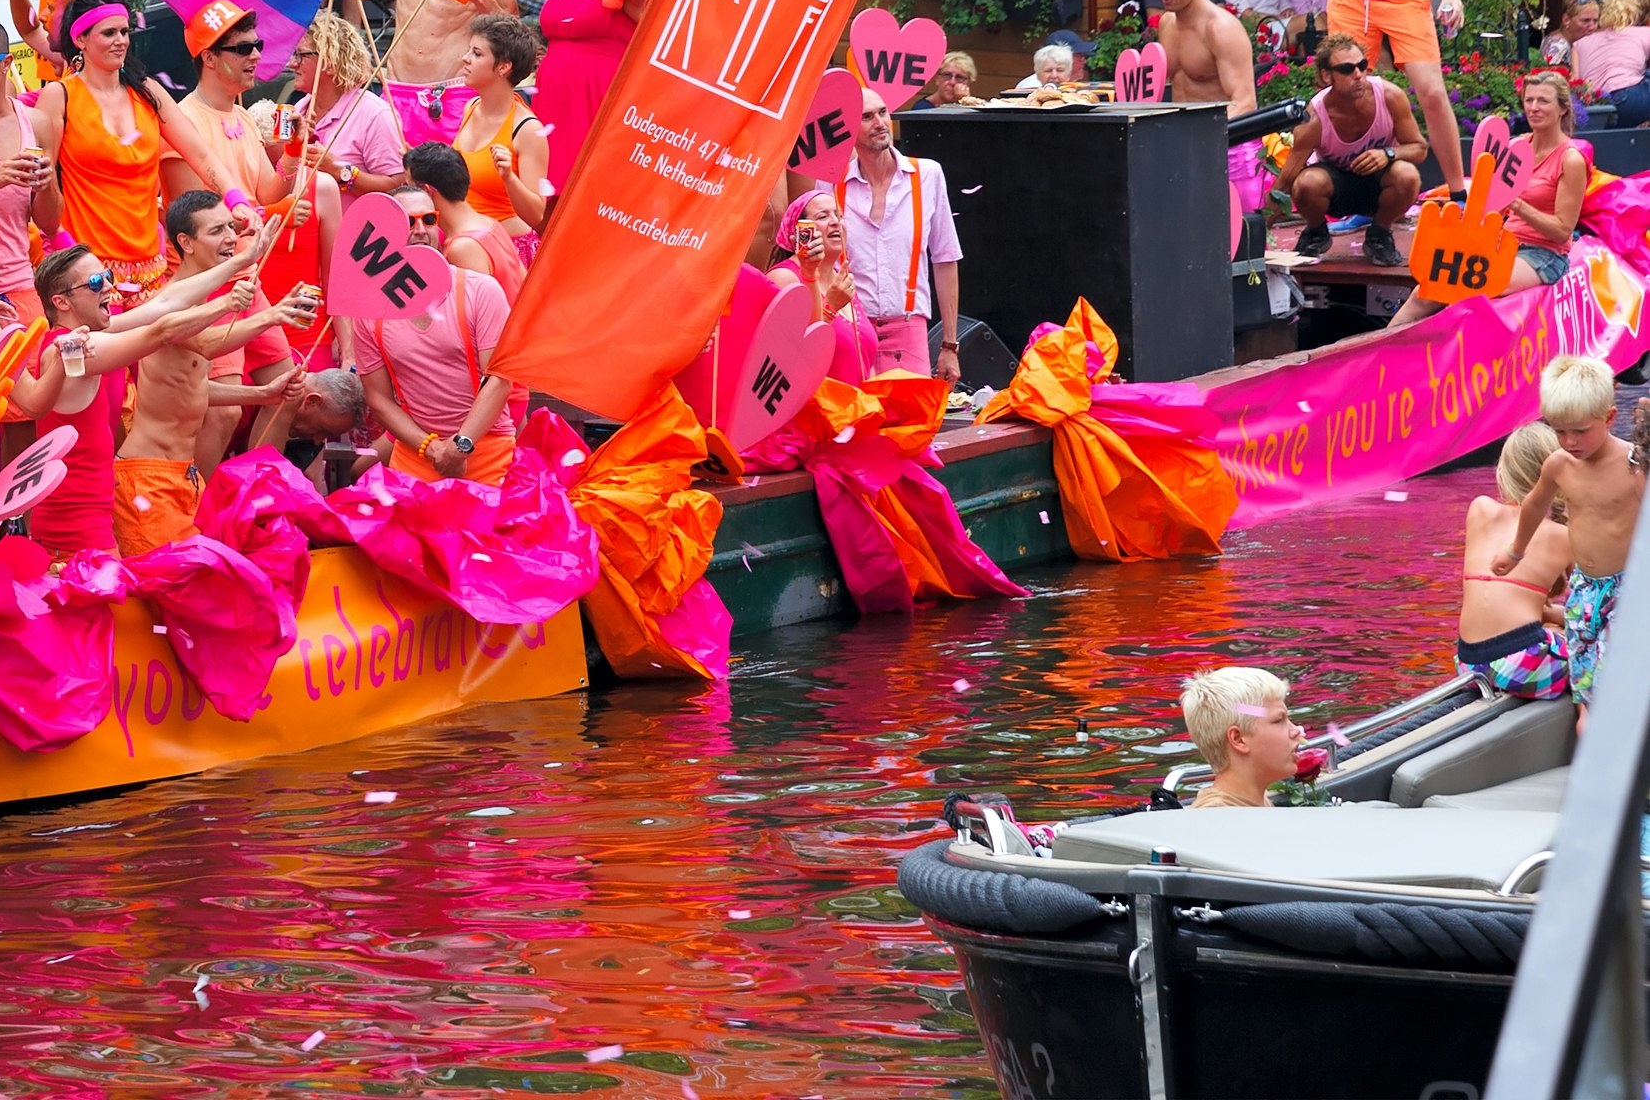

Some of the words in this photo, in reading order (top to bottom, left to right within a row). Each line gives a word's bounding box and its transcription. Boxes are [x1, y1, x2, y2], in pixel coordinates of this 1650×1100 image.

[202, 2, 236, 31] #1
[864, 49, 928, 87] WE
[1122, 64, 1154, 103] WE
[623, 104, 698, 152] Oudegracht
[698, 139, 721, 162] 47
[786, 108, 853, 169] WE
[1484, 132, 1523, 189] WE
[629, 142, 653, 168] The
[653, 153, 724, 196] Netherlands
[597, 202, 708, 250] www.cafekalff.nl
[349, 219, 428, 310] WE
[1428, 248, 1490, 290] H8
[751, 354, 791, 417] WE
[1326, 363, 1415, 487] you're
[3, 439, 54, 505] WE
